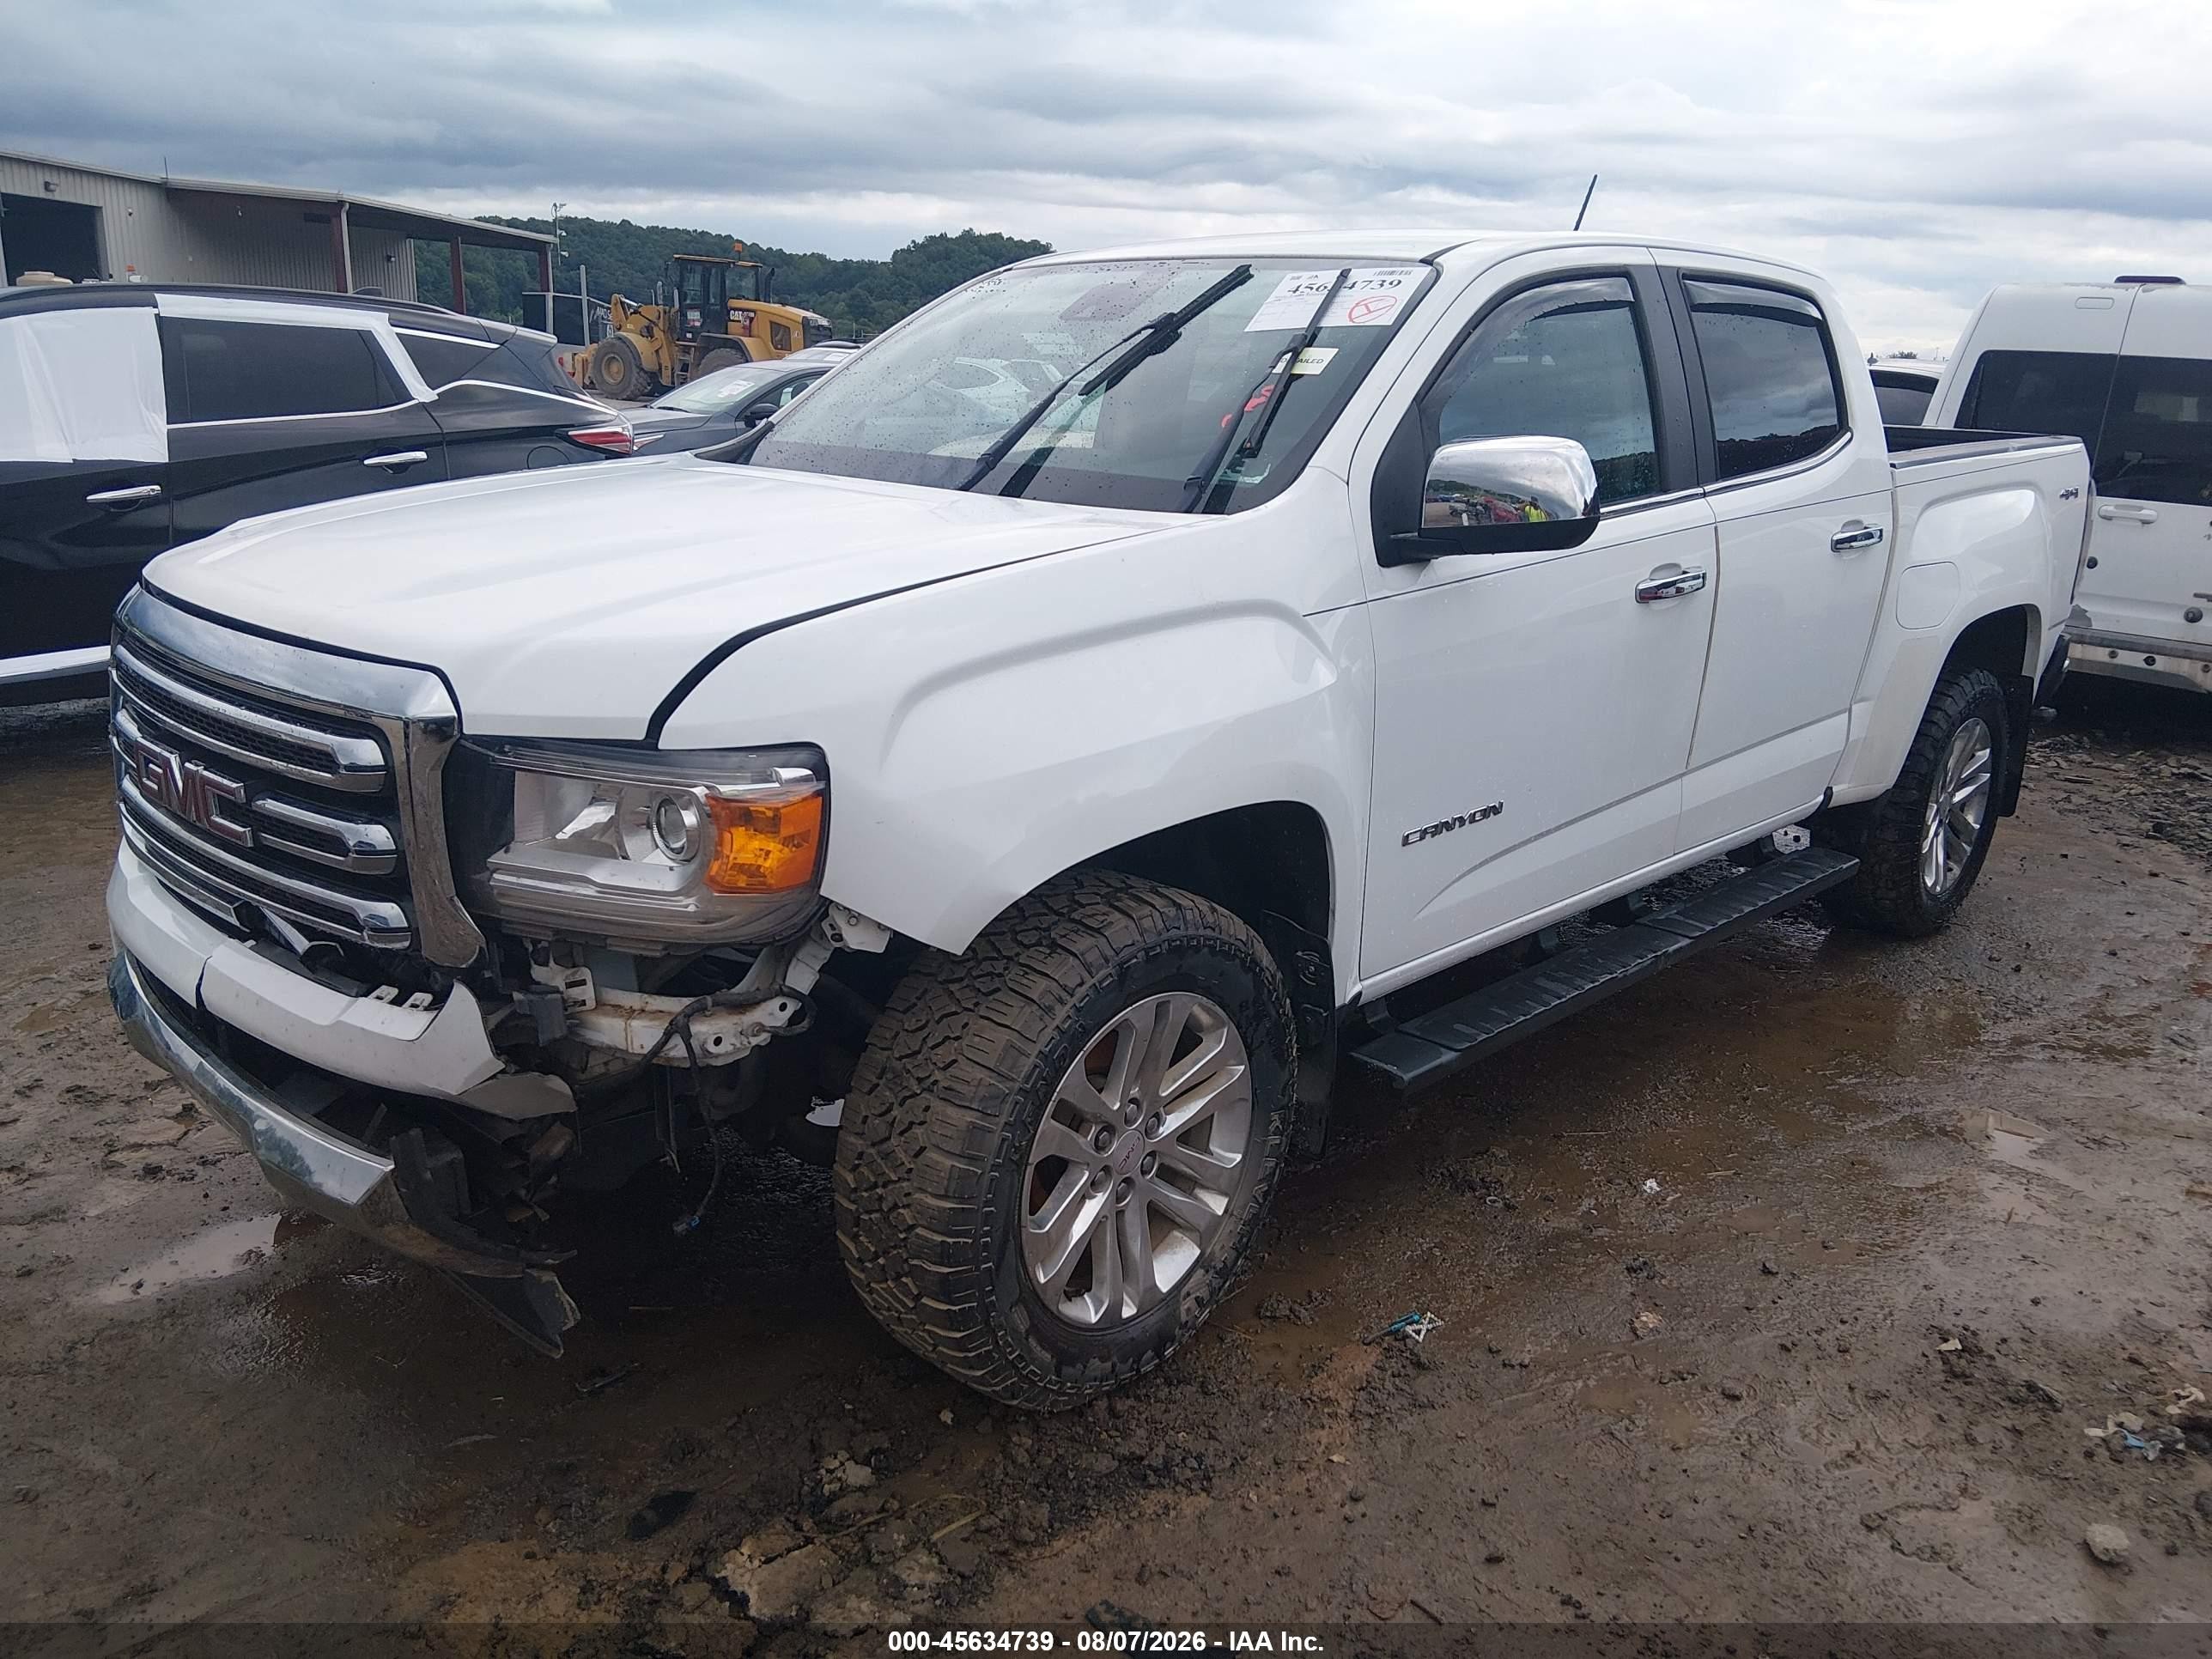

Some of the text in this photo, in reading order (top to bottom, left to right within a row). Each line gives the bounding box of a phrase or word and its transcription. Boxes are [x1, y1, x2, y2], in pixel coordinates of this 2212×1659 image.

[1287, 278, 1402, 295] 4564739
[730, 310, 743, 320] CAT
[134, 737, 254, 848] GMC
[1401, 799, 1504, 847] CANYON
[1118, 1135, 1141, 1170] GMC
